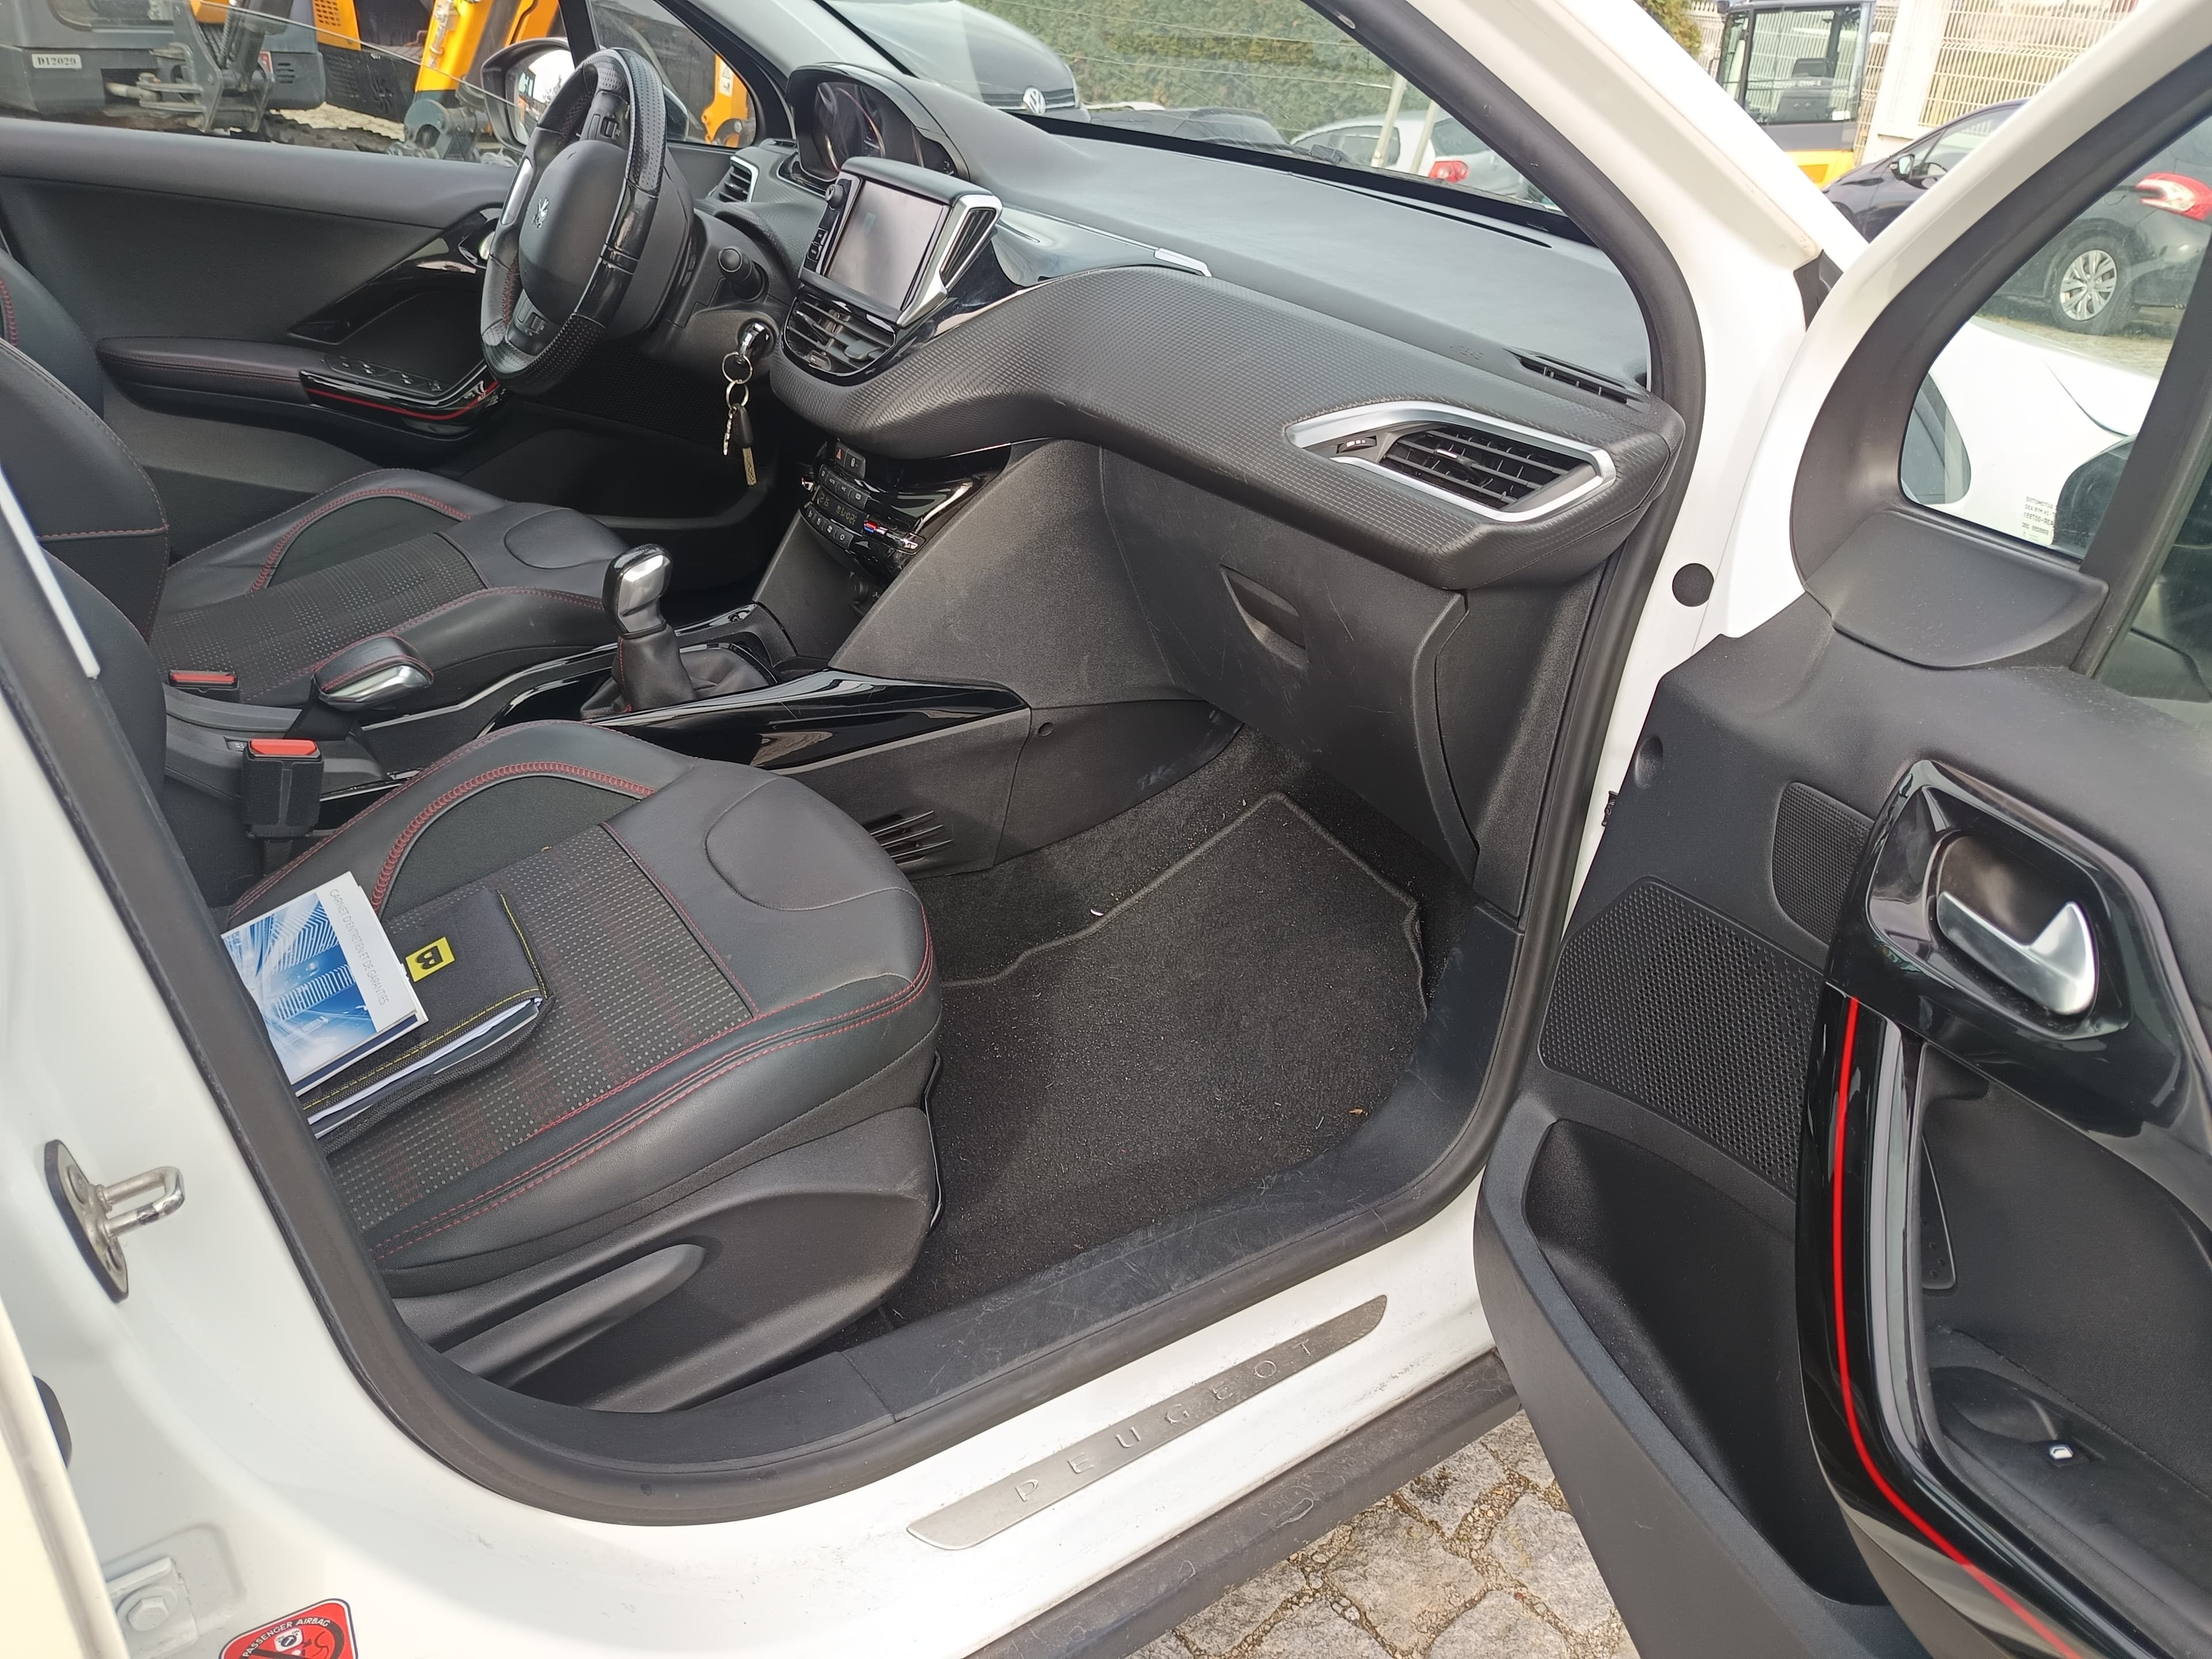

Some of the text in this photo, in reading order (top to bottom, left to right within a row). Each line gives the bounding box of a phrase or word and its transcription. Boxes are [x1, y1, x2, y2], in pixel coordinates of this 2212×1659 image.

[329, 889, 350, 916] CARNET
[359, 951, 370, 961] ET
[363, 960, 374, 971] DE
[367, 969, 389, 1005] GARANTIES
[1015, 1338, 1310, 1502] PEUGEOT
[242, 1618, 331, 1657] PASSENGER AIRBAG
